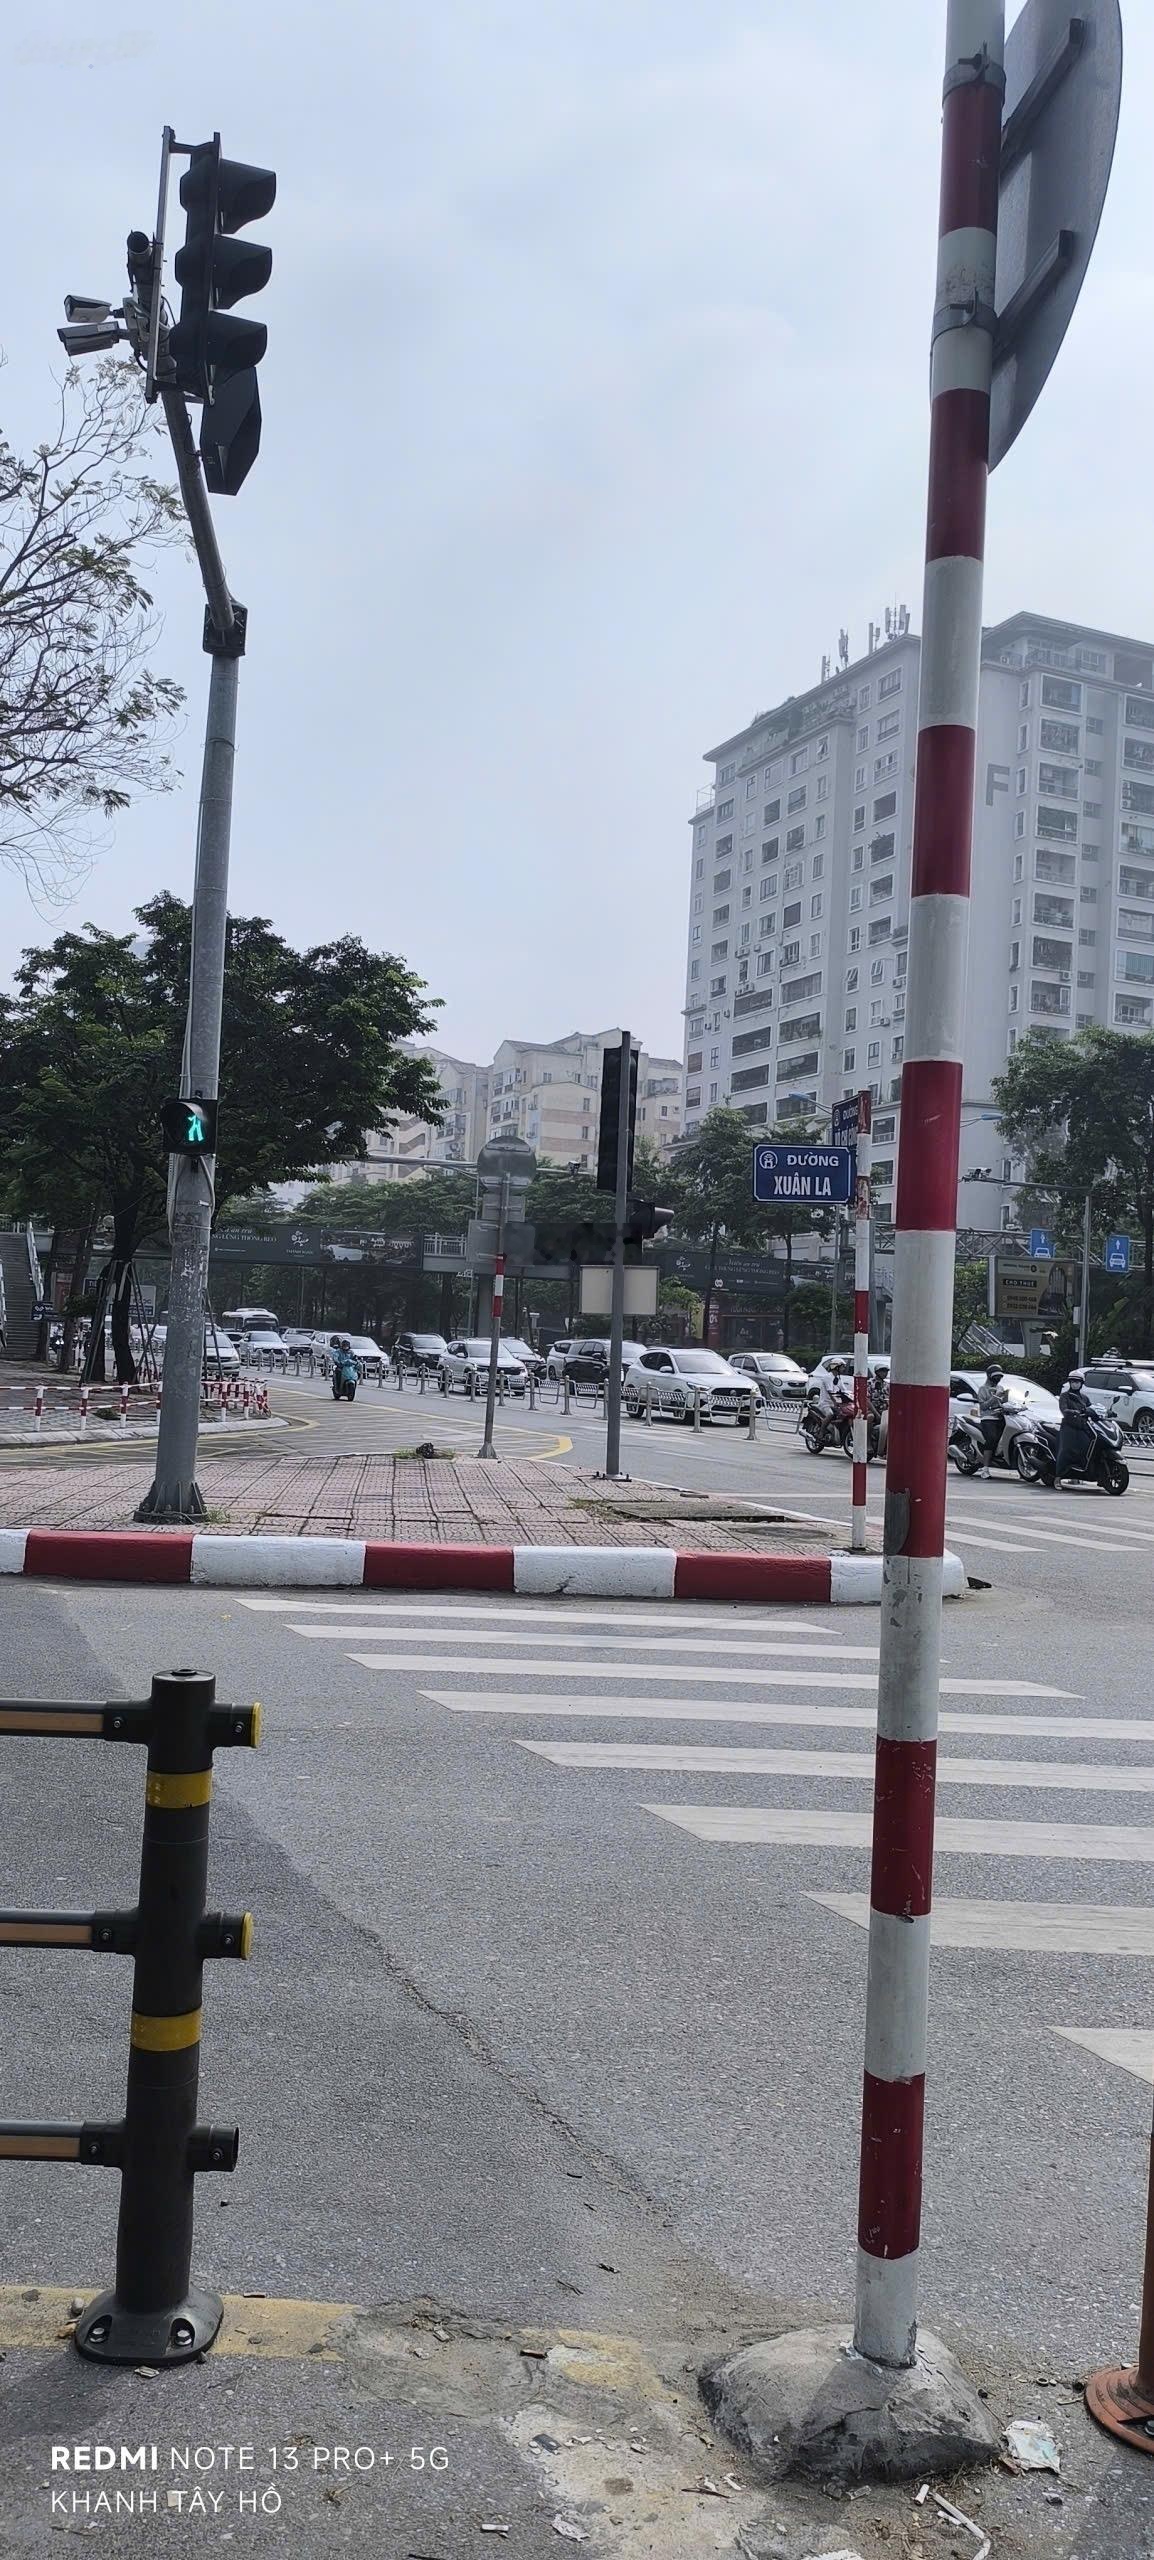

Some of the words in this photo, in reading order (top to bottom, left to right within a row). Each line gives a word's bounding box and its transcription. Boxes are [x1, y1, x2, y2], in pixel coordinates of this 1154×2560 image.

[985, 763, 1010, 806] F
[786, 1151, 840, 1167] ĐƯỜNG
[773, 1171, 811, 1196] XUÂN
[815, 1176, 832, 1196] LA
